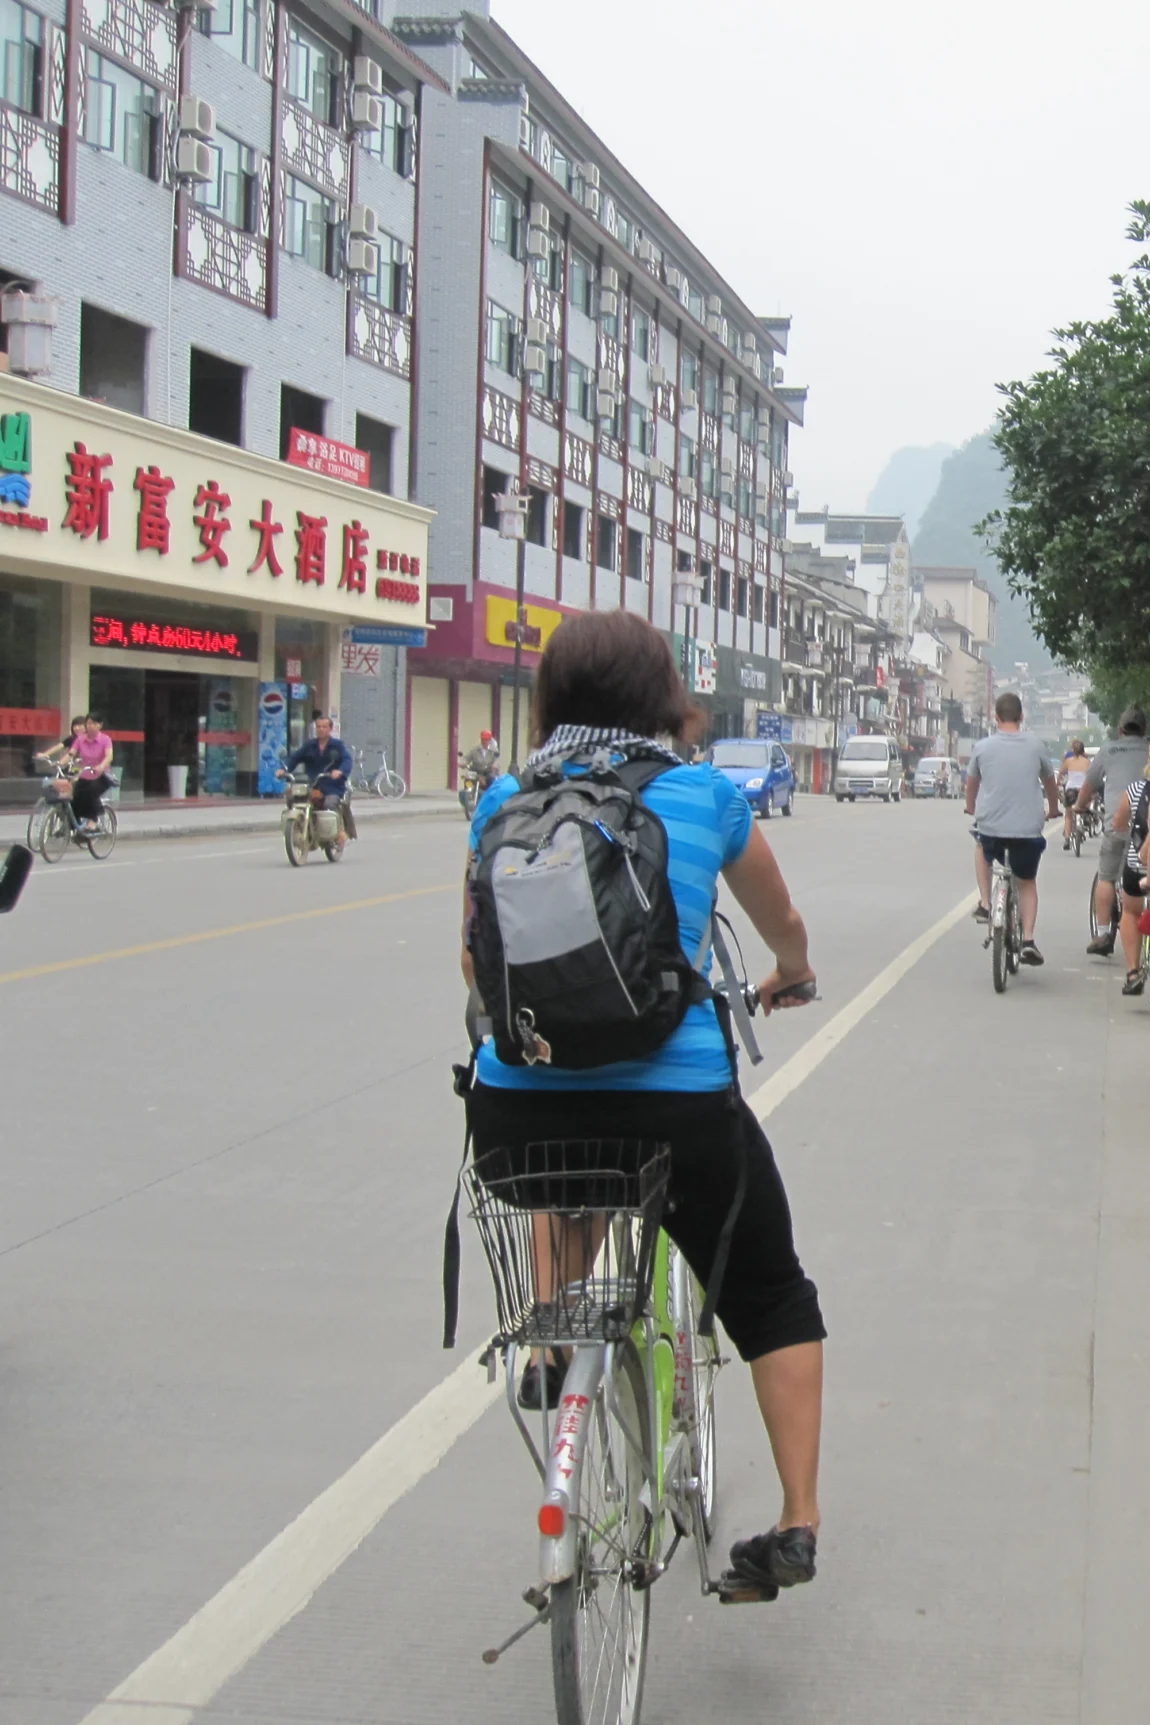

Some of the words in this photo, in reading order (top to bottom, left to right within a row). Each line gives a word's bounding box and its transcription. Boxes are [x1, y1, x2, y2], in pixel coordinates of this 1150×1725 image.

[62, 441, 371, 594] 新富安大酒店
